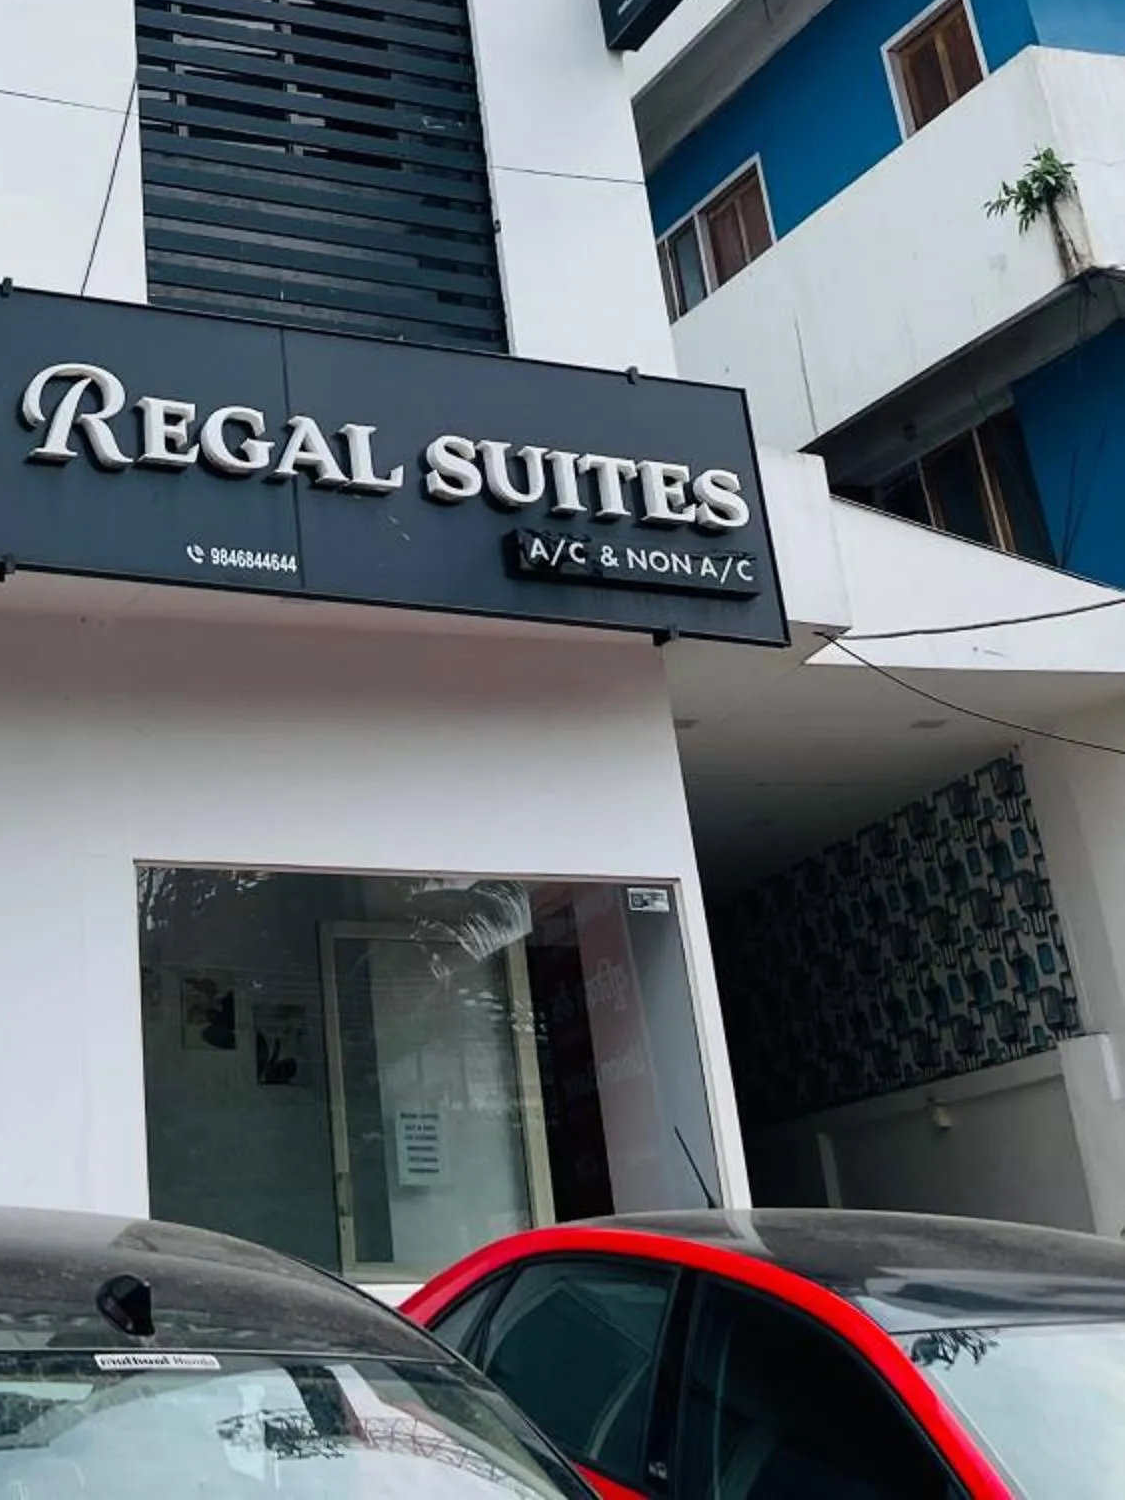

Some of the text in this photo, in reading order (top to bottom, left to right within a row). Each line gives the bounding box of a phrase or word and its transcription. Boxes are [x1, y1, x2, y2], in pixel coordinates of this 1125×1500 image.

[23, 363, 749, 530] REGAL SUITES
[210, 547, 297, 573] 9846844644
[530, 538, 753, 584] A/C & NON A/C
